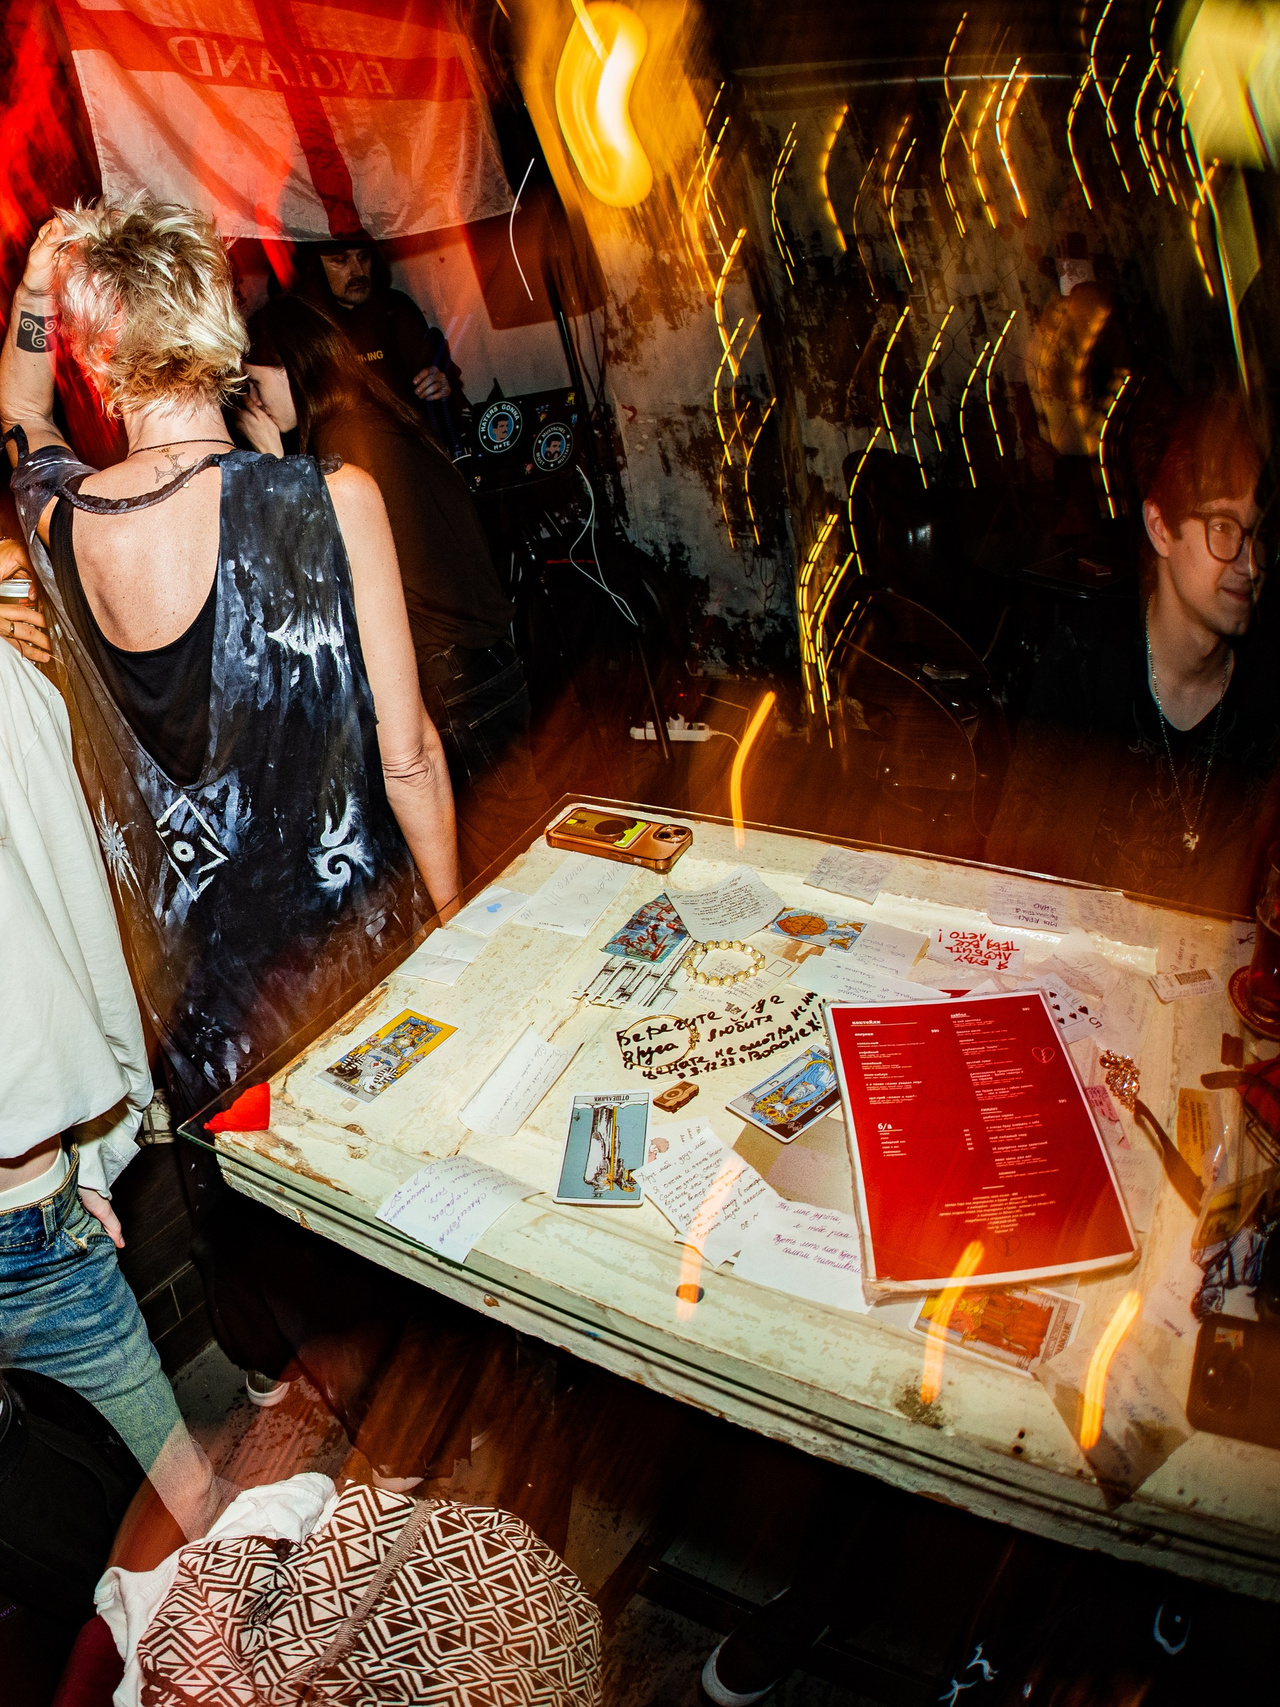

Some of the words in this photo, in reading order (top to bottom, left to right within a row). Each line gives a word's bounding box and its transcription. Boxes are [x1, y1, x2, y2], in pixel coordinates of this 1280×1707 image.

[480, 405, 499, 432] HATERS
[501, 404, 520, 421] GONNA
[949, 931, 986, 941] ЛЕТО
[987, 939, 1020, 951] ТЕБЯ
[945, 946, 1011, 961] ЛЮБИТЬ
[954, 955, 989, 966] БУДУ
[996, 961, 1008, 970] Я
[1088, 1016, 1103, 1029] 5
[617, 1011, 722, 1046] Берегите
[623, 1042, 678, 1070] друга
[594, 1094, 630, 1103] ОТШЕЛЬНИК
[877, 1122, 893, 1131] б/а
[793, 1207, 811, 1216] мне
